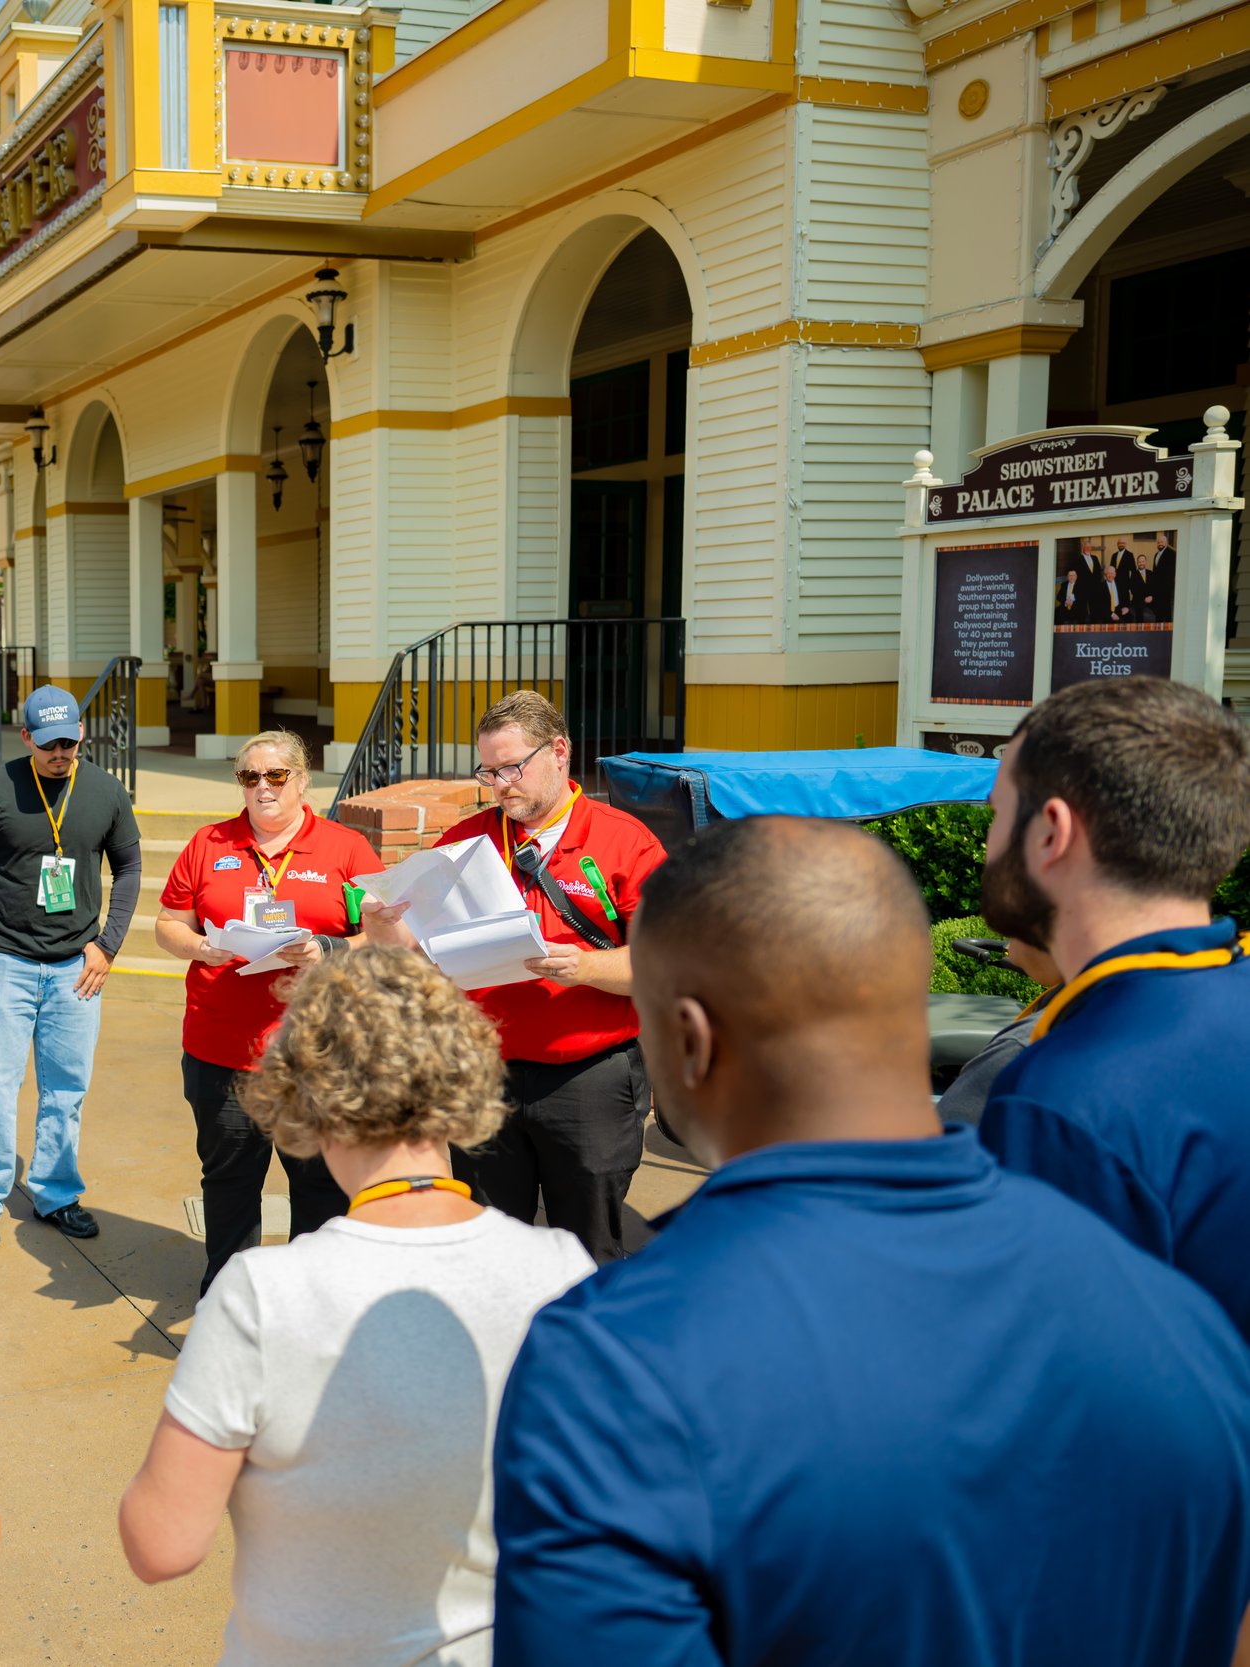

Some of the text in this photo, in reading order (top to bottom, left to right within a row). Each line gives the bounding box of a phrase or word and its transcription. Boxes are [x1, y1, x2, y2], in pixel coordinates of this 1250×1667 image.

[1000, 451, 1107, 481] SHOWSTREET
[956, 470, 1160, 513] PALACE THEATER
[966, 573, 1009, 583] Dollywood's
[960, 582, 1014, 592] award-winning
[957, 592, 1017, 602] Southern gospel
[959, 603, 979, 612] group
[981, 602, 994, 610] has
[964, 611, 1008, 620] entertaining
[953, 621, 1018, 630] Dollywood guests
[958, 630, 968, 638] for
[982, 631, 1002, 640] years
[961, 640, 1008, 648] they perform
[954, 649, 1015, 659] their biggest hits
[1075, 643, 1148, 661] Kingdom
[959, 658, 1007, 668] of inspiration
[1090, 661, 1131, 675] Heirs
[978, 668, 1003, 677] praise.
[38, 705, 68, 716] BELMONT
[46, 713, 63, 722] PARK
[960, 744, 979, 754] 11:00
